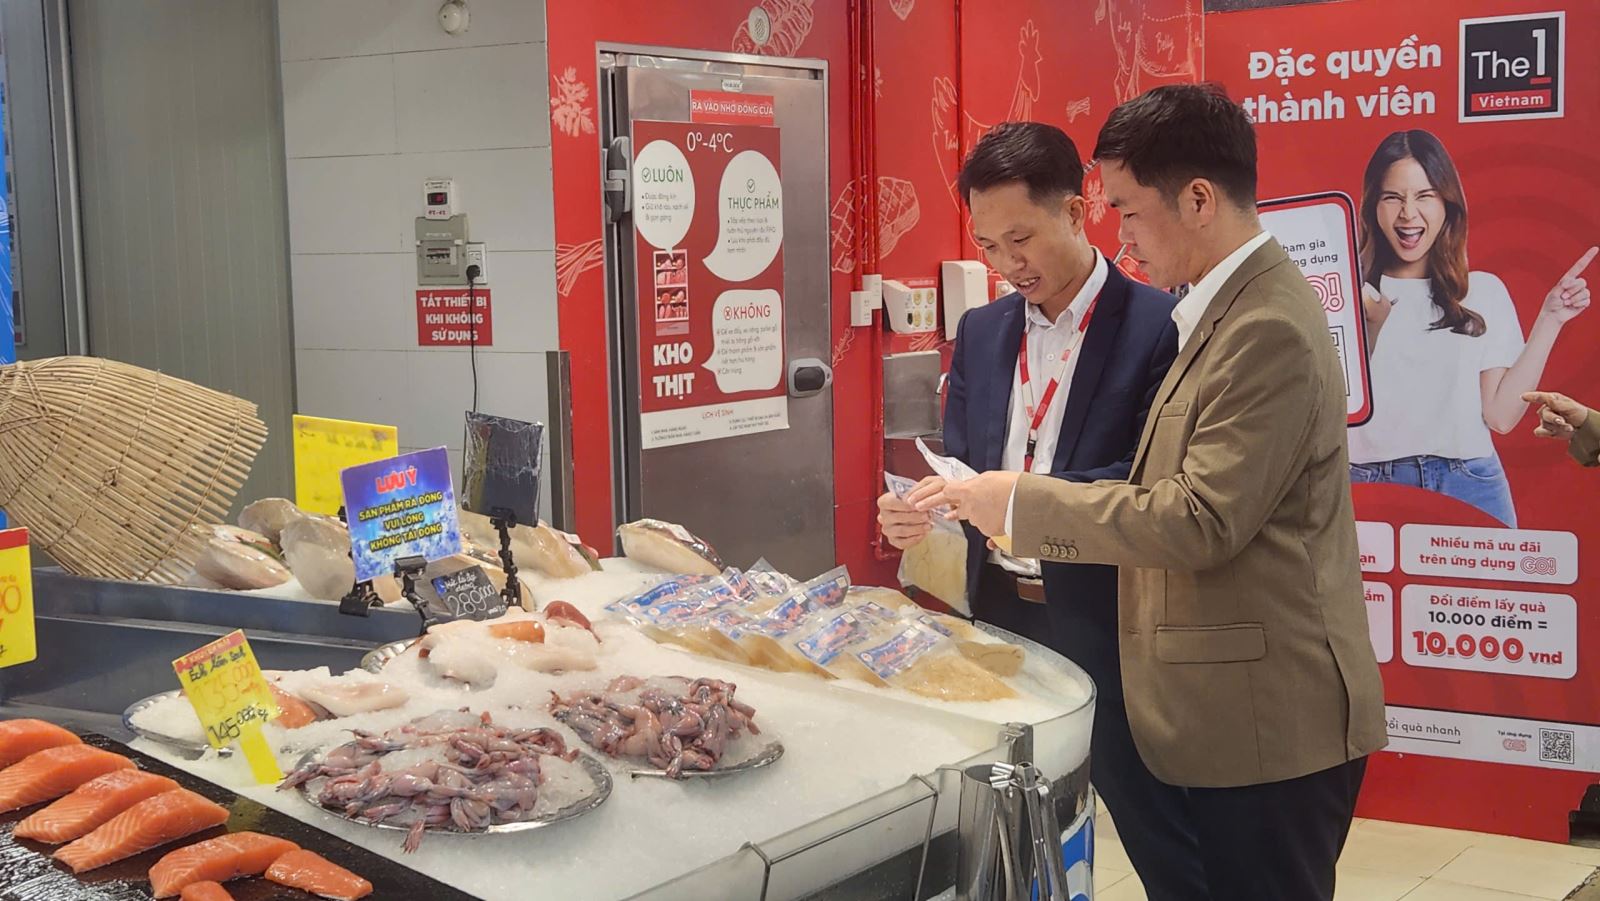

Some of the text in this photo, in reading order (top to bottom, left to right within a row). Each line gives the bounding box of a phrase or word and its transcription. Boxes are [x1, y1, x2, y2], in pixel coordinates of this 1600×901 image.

[1249, 35, 1441, 85] Đặc quyền
[1472, 51, 1530, 79] The
[692, 102, 702, 110] RA
[704, 98, 718, 112] VÀO
[1242, 85, 1435, 123] thành viên
[1479, 94, 1544, 108] Vietnam
[653, 165, 683, 182] LUÔN
[728, 191, 779, 212] THỰC PHẨM
[1283, 239, 1326, 252] ham gia
[1293, 254, 1338, 267] ng dụng
[421, 292, 441, 307] TẮT
[476, 297, 487, 309] BỊ
[426, 311, 483, 324] KHI KHÔNG
[734, 302, 770, 319] KHÔNG
[432, 327, 447, 340] SỬ
[653, 342, 693, 366] KHO
[653, 372, 695, 400] THỊT
[376, 465, 417, 494] LƯU Ý
[419, 490, 443, 504] ĐÔNG
[384, 512, 424, 530] VUI LÒNG
[370, 534, 400, 550] KHÔNG
[419, 523, 442, 537] ĐÔNG
[1430, 536, 1541, 553] Nhiều mã ưu đãi
[1360, 554, 1376, 566] ạn
[1420, 554, 1556, 576] trên ứng dụng GO!
[1365, 588, 1384, 602] ắm
[1430, 594, 1546, 616] Đổi điểm lấy quà
[1429, 610, 1548, 630] 10.000 điểm =
[1412, 630, 1562, 664] 10.000 vnd
[1386, 717, 1460, 736] ổi quà nhanh
